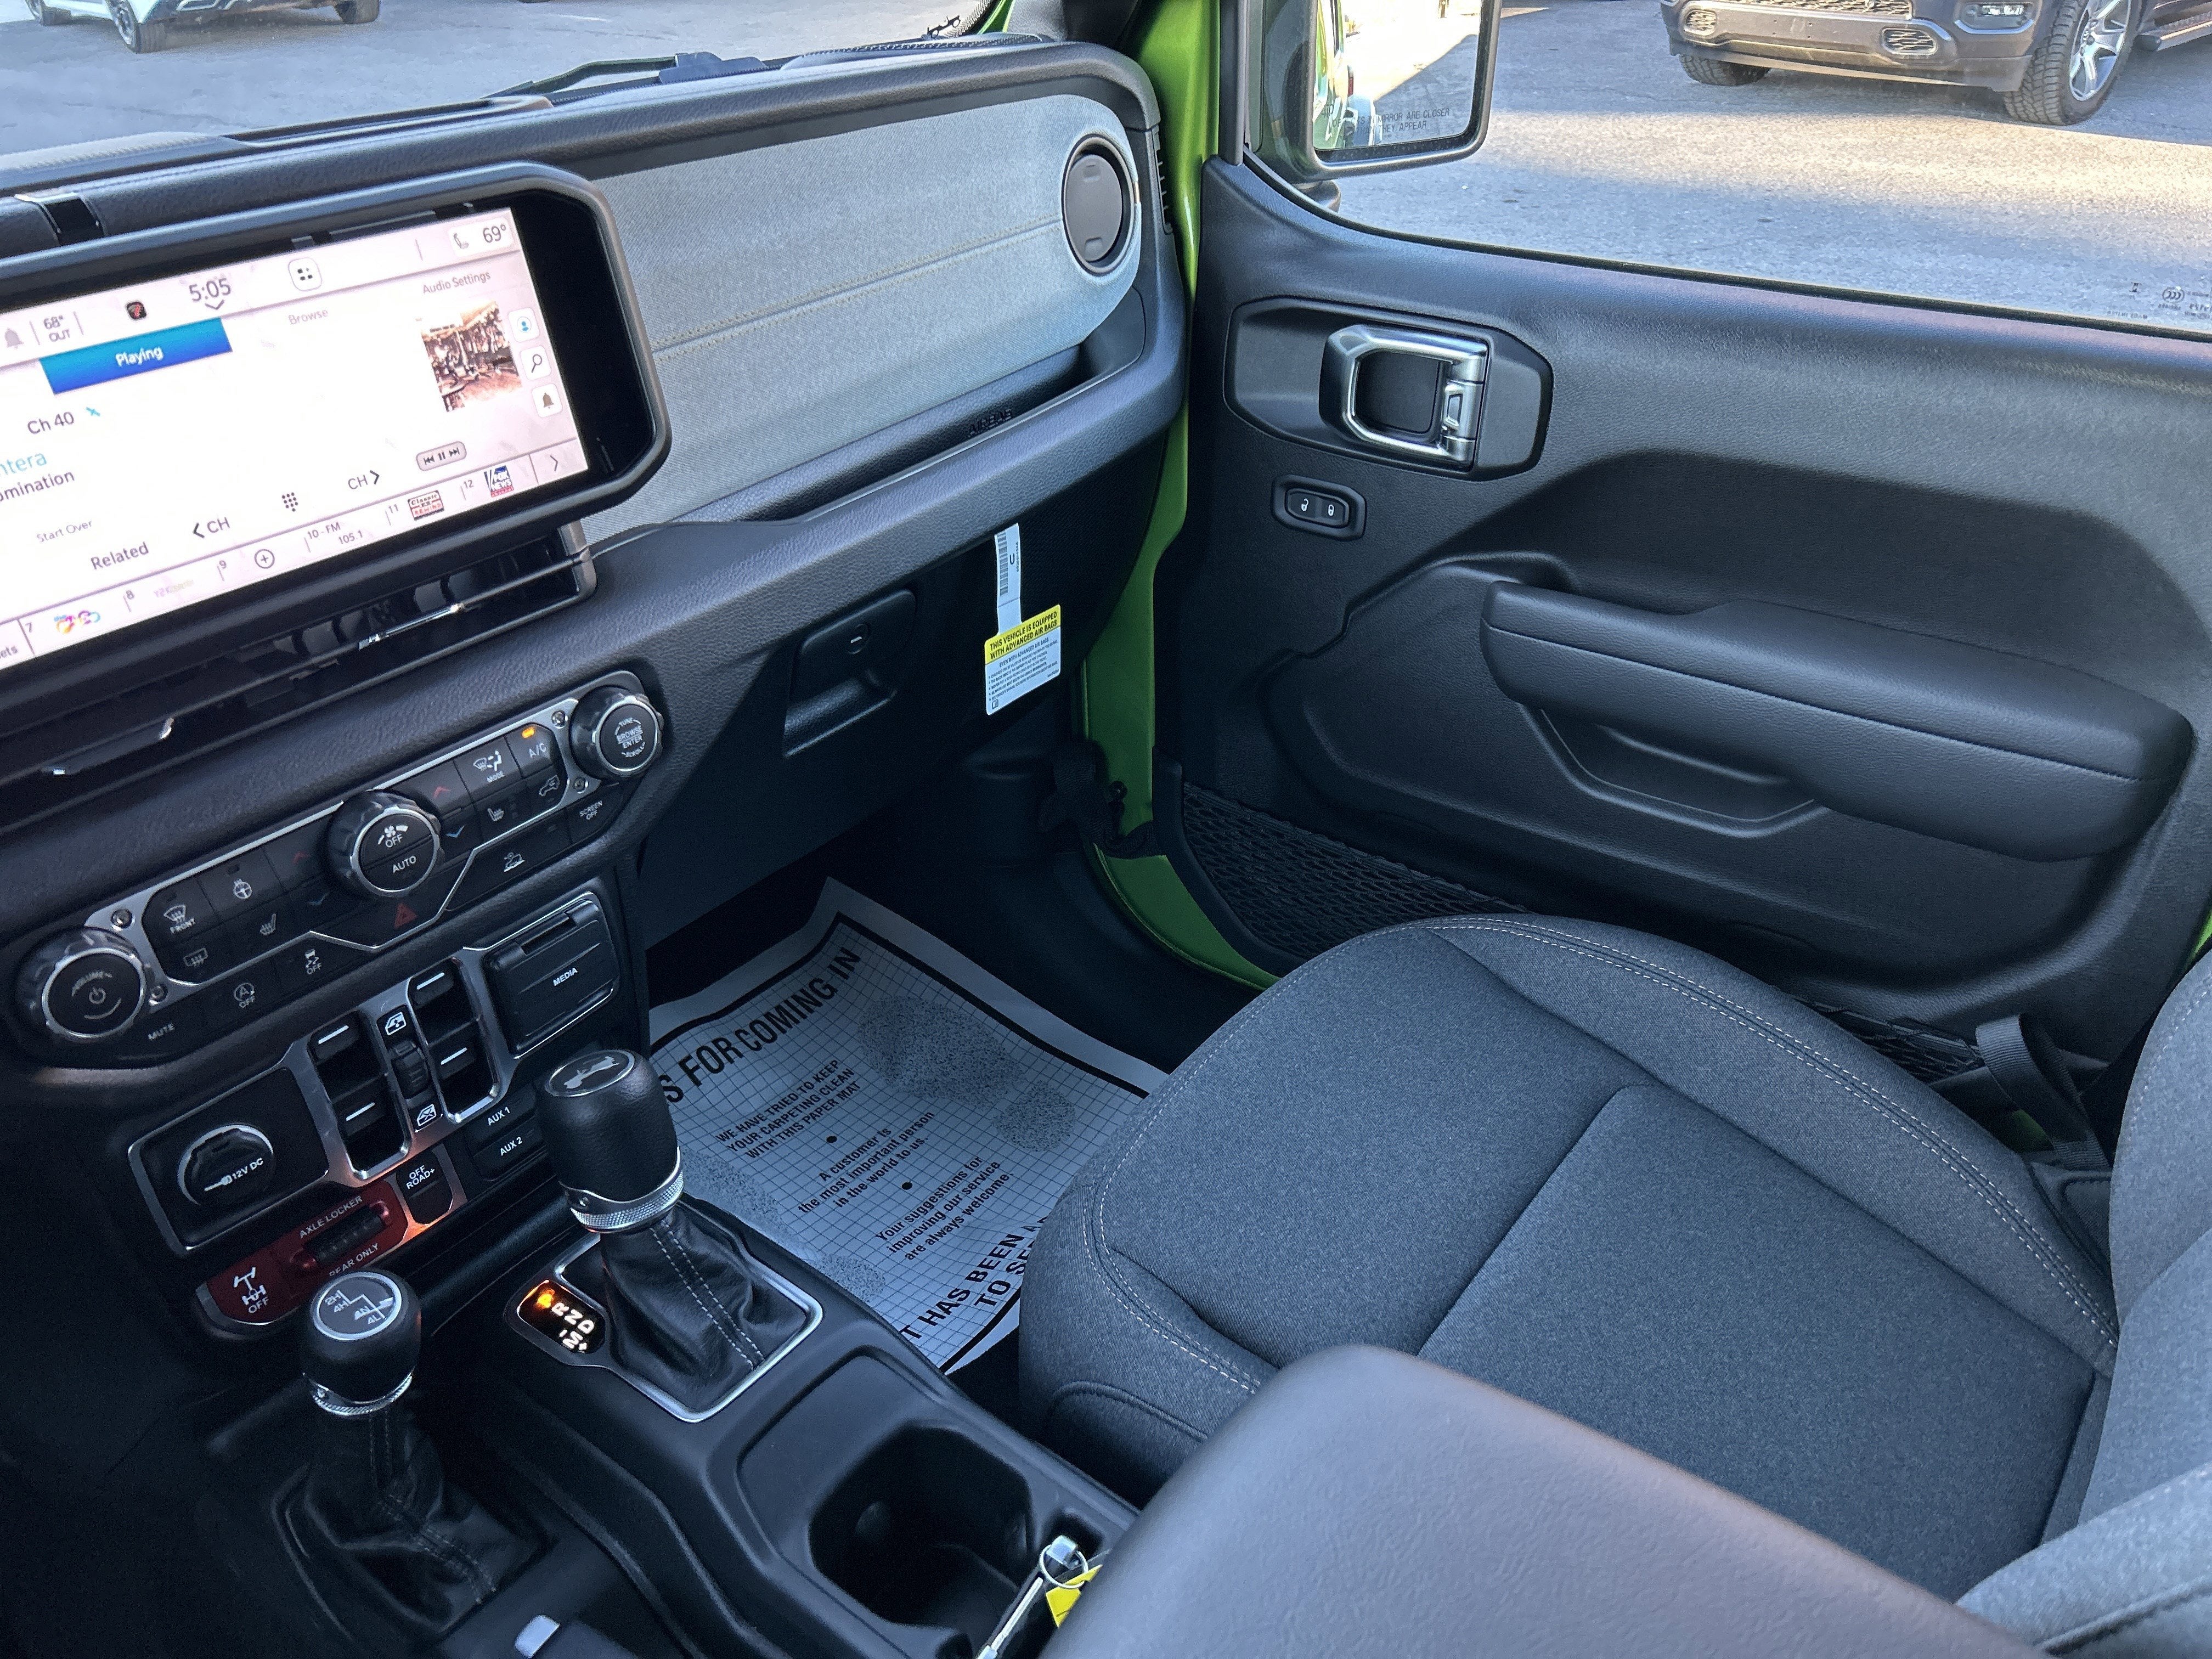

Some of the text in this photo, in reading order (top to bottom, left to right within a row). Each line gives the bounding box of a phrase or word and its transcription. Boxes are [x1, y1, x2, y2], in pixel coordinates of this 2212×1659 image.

[1407, 110, 1420, 120] ARE
[1423, 108, 1449, 119] CLOSER
[1400, 120, 1427, 131] APPEAR
[188, 278, 232, 303] 5:05
[422, 270, 492, 295] Audio Settings
[288, 308, 329, 325] Browse
[49, 329, 71, 342] OUT
[115, 345, 164, 368] Playing
[27, 411, 75, 435] Ch 40
[347, 474, 368, 490] CH
[463, 479, 475, 489] 12
[411, 494, 438, 506] Classic
[388, 504, 399, 515] 11
[36, 520, 93, 544] Start Over
[206, 516, 230, 534] CH
[307, 527, 319, 540] 10
[326, 521, 341, 534] FM
[338, 530, 364, 545] 105.1
[91, 541, 150, 571] Related
[990, 611, 1058, 651] THIS VEHICLE IS EQUIPPED
[990, 619, 1058, 660] WITH ADVANCED AIR BAGS
[616, 725, 642, 742] BROWSE
[622, 735, 642, 749] ENTER
[528, 743, 548, 759] A/C
[486, 772, 505, 784] MODE
[579, 800, 603, 819] SCREEN
[585, 808, 599, 821] OFF
[385, 833, 404, 849] OFF
[392, 855, 417, 874] AUTO
[170, 918, 196, 934] FRONT
[306, 962, 323, 975] OFF
[552, 966, 578, 988] MEDIA
[238, 994, 256, 1008] OFF
[678, 1036, 744, 1087] FOR
[734, 977, 839, 1052] COMING
[827, 947, 862, 980] IN
[148, 1023, 175, 1041] MUTE
[715, 1059, 839, 1143] WE HAVE TRIED TO KEEP
[727, 1068, 855, 1152] YOUR CARPETING CLEAN
[487, 1110, 504, 1126] AUX
[745, 1080, 861, 1159] WITH THIS PAPER MAT
[499, 1136, 523, 1156] AUX 2
[819, 1128, 892, 1182] A customer is
[231, 1157, 264, 1181] 12V DC
[798, 1111, 935, 1214] the most important person
[408, 1164, 426, 1180] OFF
[832, 1137, 929, 1207] in the world to us.
[875, 1155, 983, 1242] Your suggestions for
[886, 1161, 1001, 1254] improving our service
[299, 1194, 363, 1238] AXLE LOCKER
[905, 1173, 1014, 1261] are always welcome.
[356, 1242, 379, 1263] ONLY
[917, 1288, 971, 1327] HAS
[964, 1233, 1025, 1283] BEEN
[325, 1292, 341, 1306] 2H
[973, 1280, 1012, 1306] TO
[248, 1296, 269, 1314] OFF
[334, 1300, 349, 1313] 4H
[551, 1302, 569, 1317] R
[368, 1314, 381, 1325] 4L
[564, 1308, 583, 1325] N
[578, 1319, 595, 1334] D
